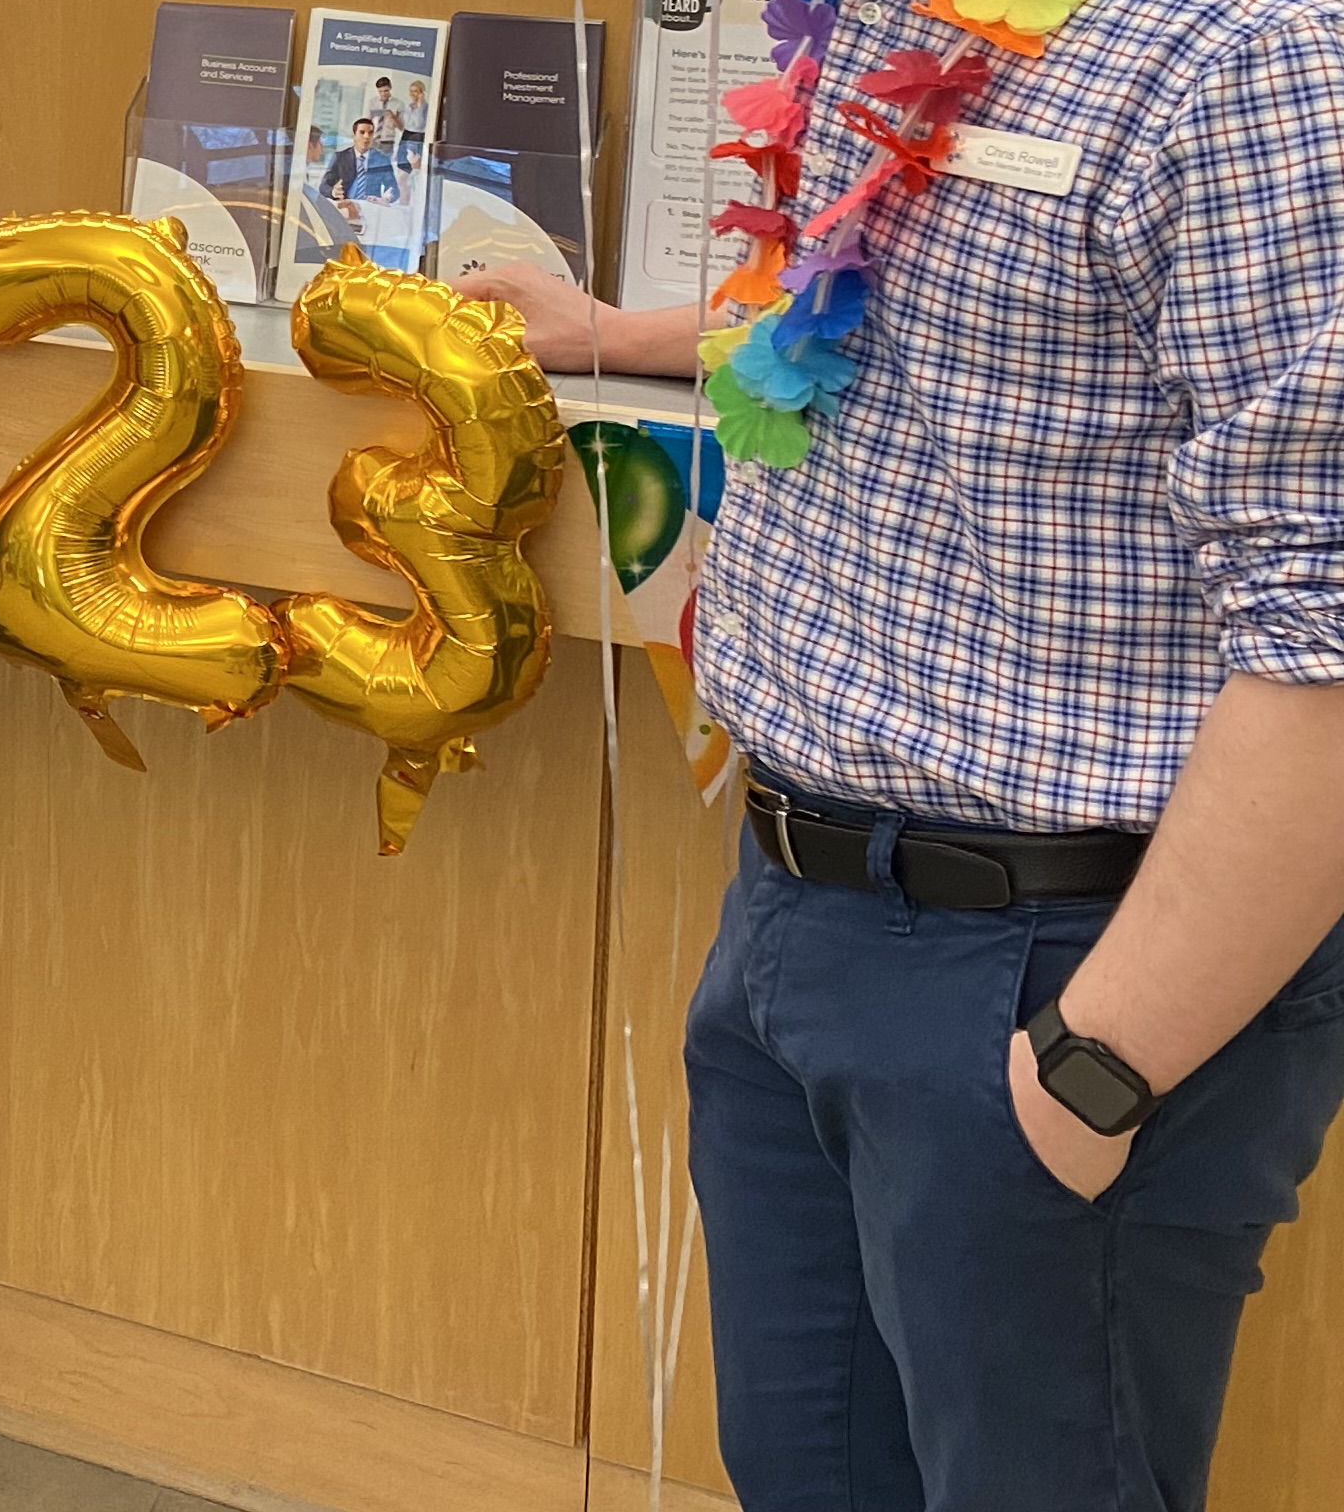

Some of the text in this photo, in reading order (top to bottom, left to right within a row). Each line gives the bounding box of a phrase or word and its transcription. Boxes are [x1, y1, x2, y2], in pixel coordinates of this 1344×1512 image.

[335, 31, 343, 40] A
[383, 36, 422, 48] Employee
[329, 41, 426, 58] Pension Plan for Business
[672, 49, 707, 60] Here's
[734, 54, 759, 64] they
[201, 58, 278, 74] Business Accounts
[199, 70, 254, 82] and Services
[503, 70, 559, 82] Professional
[503, 81, 554, 93] Investment
[502, 92, 566, 105] Management
[985, 145, 1059, 168] Chris Rowell
[188, 241, 246, 257] ascoma
